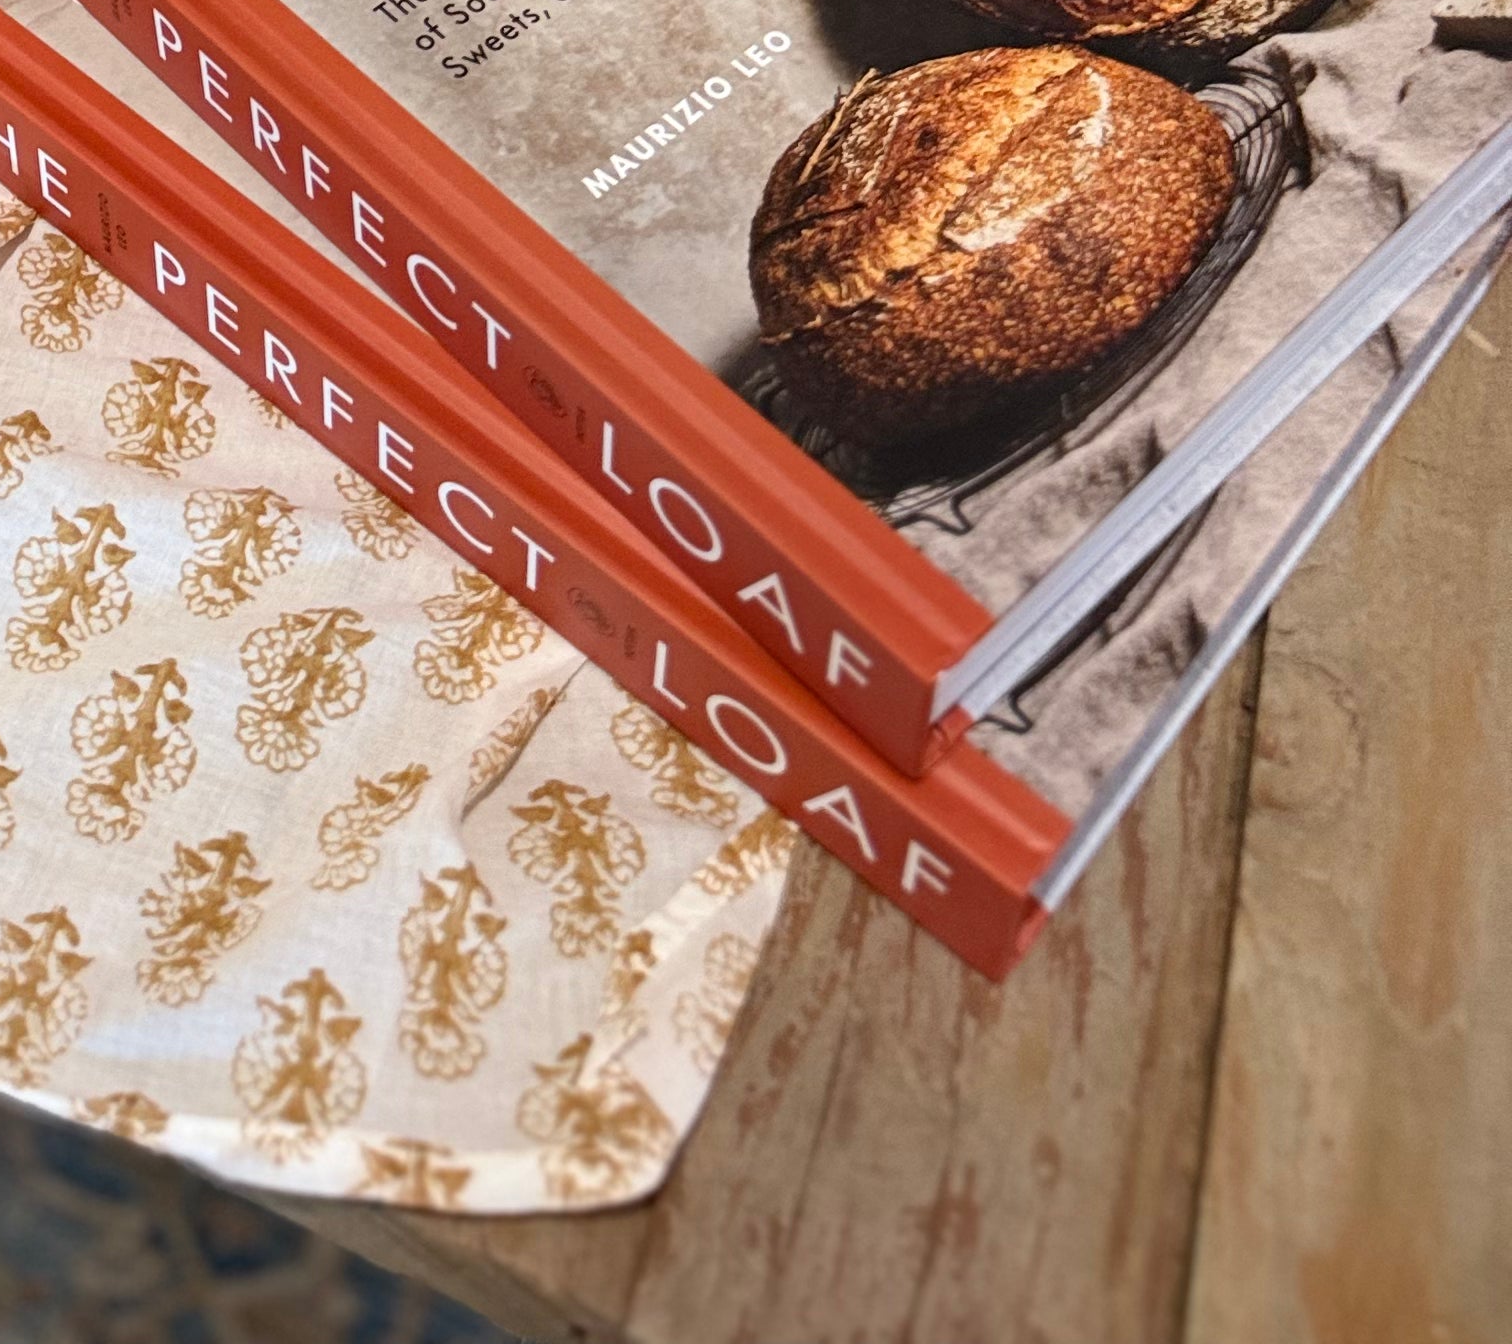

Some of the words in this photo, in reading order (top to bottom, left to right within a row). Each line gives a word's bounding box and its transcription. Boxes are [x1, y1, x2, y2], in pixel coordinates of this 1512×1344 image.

[415, 16, 446, 51] of
[441, 7, 551, 79] Sweets,
[581, 76, 732, 199] MAURIZIO
[731, 30, 791, 78] LEO
[152, 8, 511, 370] PERFECT
[602, 420, 873, 688] LOAF
[152, 240, 555, 592] PERFECT
[652, 639, 951, 895] LOAF
